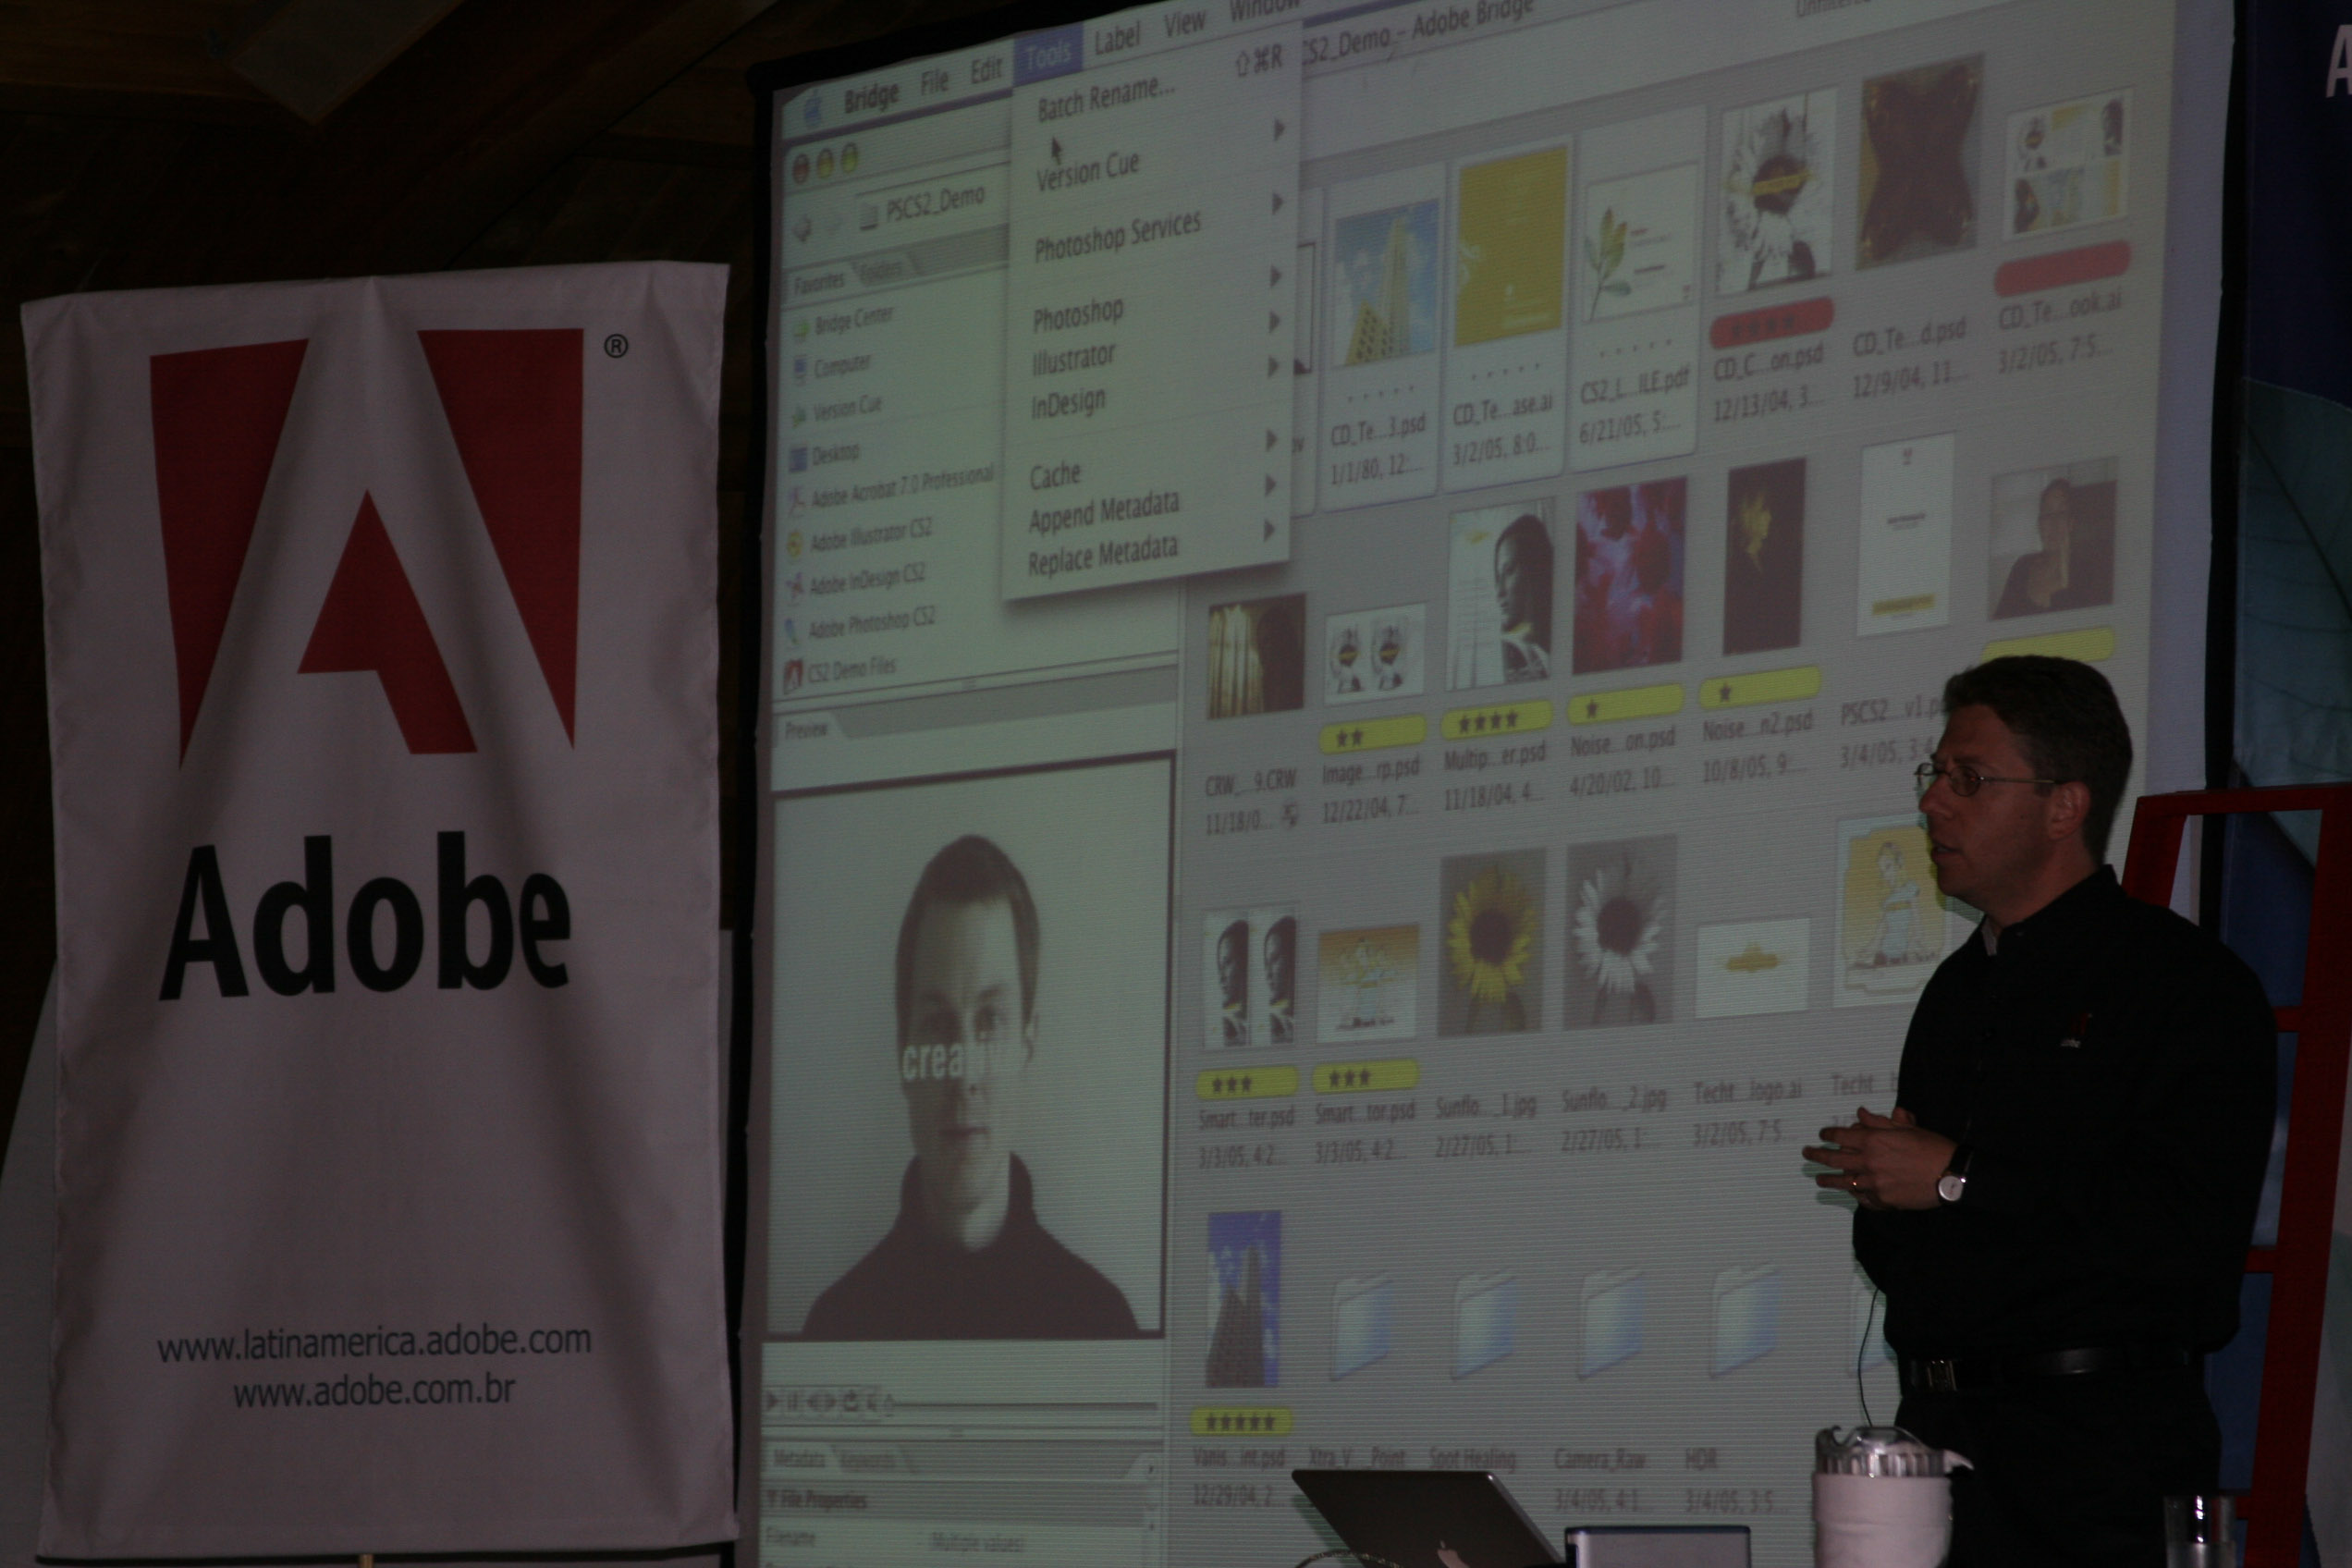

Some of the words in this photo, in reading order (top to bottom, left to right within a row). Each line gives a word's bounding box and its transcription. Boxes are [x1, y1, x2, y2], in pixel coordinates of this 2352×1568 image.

[1413, 7, 1470, 40] Adobe
[1477, 0, 1535, 25] Bridge
[845, 80, 900, 113] Bridge
[921, 70, 949, 95] File
[971, 60, 1003, 84] Edit
[1025, 43, 1072, 71] Tools
[1095, 27, 1140, 55] Label
[1165, 12, 1206, 37] View
[1038, 95, 1084, 123] Batch
[1089, 76, 1175, 105] Rename...
[1036, 159, 1100, 192] Version
[1106, 151, 1140, 178] Cue
[886, 185, 986, 223] PSCS2_Demo
[1035, 227, 1125, 263] Photoshop
[1132, 212, 1202, 240] Services
[794, 267, 845, 294] Favorites
[815, 309, 851, 336] Bridge
[855, 305, 893, 330] Center
[1033, 297, 1124, 334] Photoshop
[815, 353, 870, 381] Computer
[1033, 341, 1117, 376] Illustrator
[1853, 365, 1928, 399] 12/9/04,
[814, 398, 853, 422] Version
[859, 397, 881, 415] Cue
[1031, 386, 1106, 420] InDesign
[1714, 388, 1795, 423] 12/13/04,
[1579, 413, 1647, 446] 6/21/05,
[813, 442, 860, 466] Desktop
[1453, 440, 1507, 468] 3/2/05,
[811, 486, 849, 509] Adobe
[852, 481, 896, 504] Acrobat
[900, 475, 918, 496] 7.0
[922, 463, 994, 494] Professional
[1030, 462, 1082, 492] Cache
[1331, 457, 1383, 486] 1/1/80,
[1029, 498, 1094, 534] Append
[1101, 488, 1180, 523] Metadata
[811, 529, 847, 553] Adobe
[851, 521, 906, 547] Illustrator
[911, 519, 932, 539] CS2
[1028, 545, 1094, 578] Replace
[1099, 533, 1179, 564] Metadata
[810, 573, 845, 594] Adobe
[848, 569, 901, 591] InDesign
[904, 562, 925, 582] CS2
[809, 618, 845, 639] Adobe
[849, 610, 910, 635] Photoshop
[913, 606, 936, 626] CS2
[808, 663, 829, 683] CS2
[833, 659, 869, 680] Demo
[871, 655, 897, 675] Files
[785, 720, 828, 740] Preview
[159, 831, 571, 1000] Adobe
[157, 1323, 592, 1363] www.latinamerica.adobe.com
[234, 1372, 517, 1408] www.adobe.com.br
[1464, 1446, 1516, 1472] Healing
[807, 1491, 867, 1513] Properties
